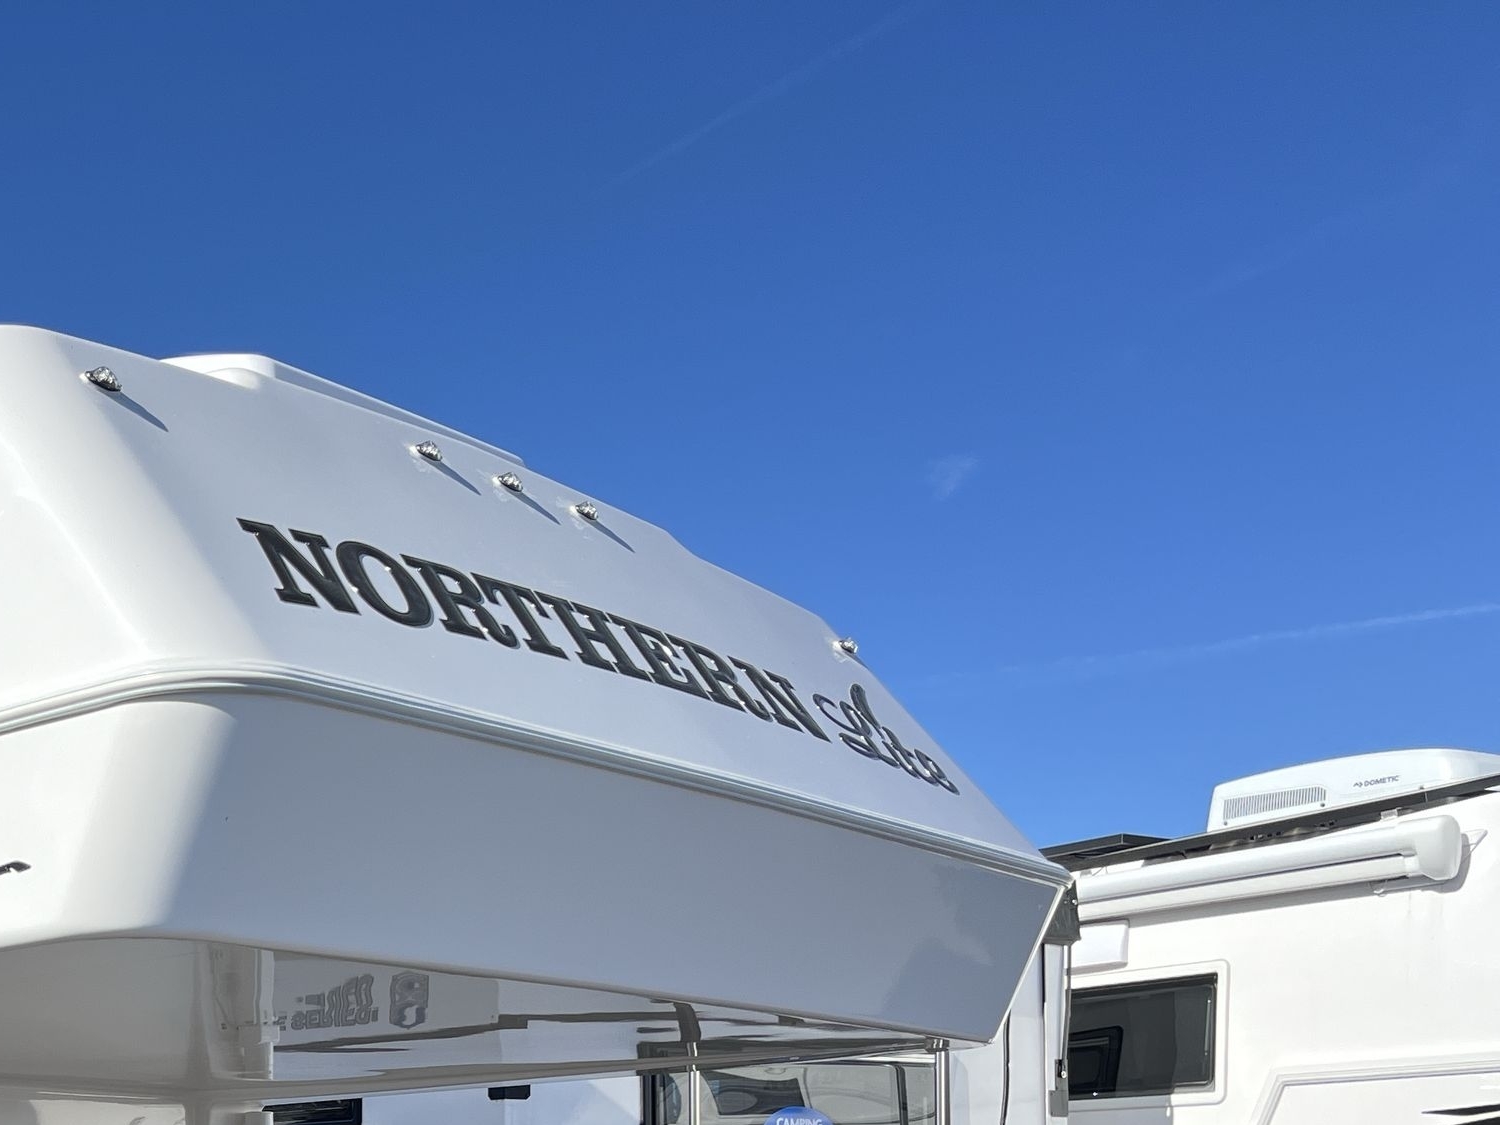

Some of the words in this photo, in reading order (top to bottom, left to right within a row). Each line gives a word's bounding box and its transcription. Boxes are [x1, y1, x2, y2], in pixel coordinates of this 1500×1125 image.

[237, 517, 831, 742] NORTHERN
[812, 683, 960, 796] Lite
[1364, 775, 1399, 787] DOMETIC
